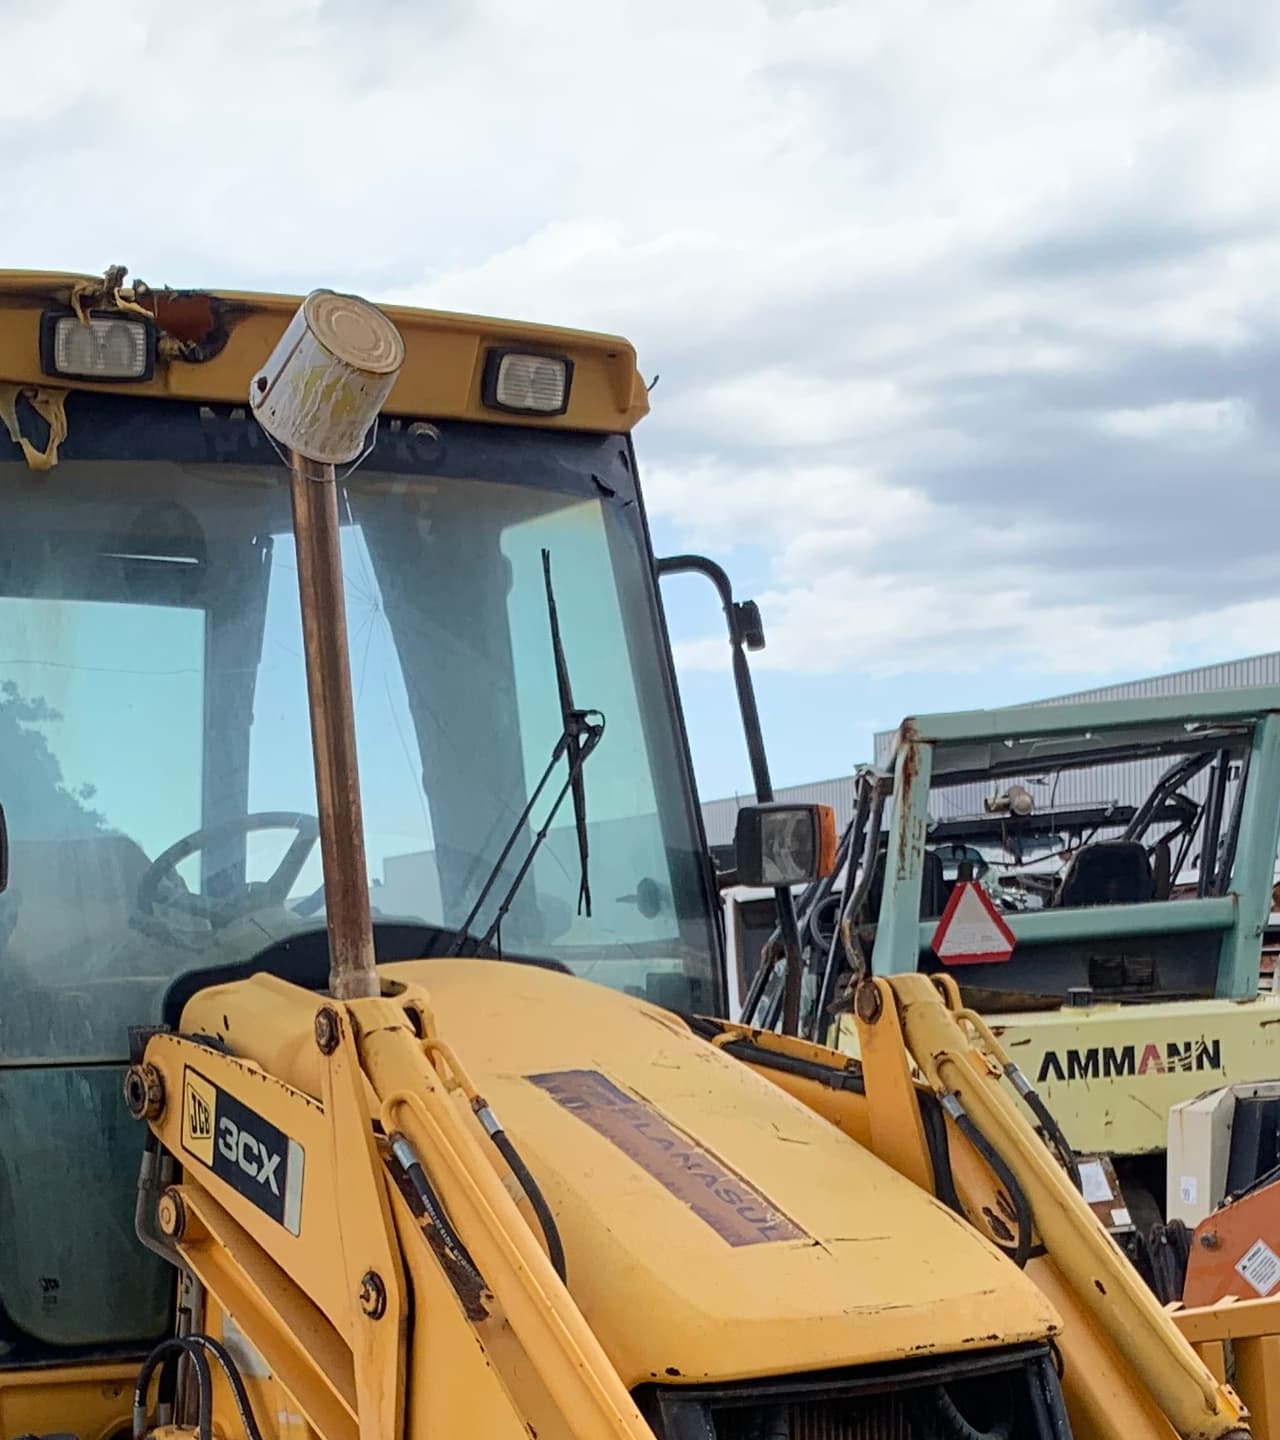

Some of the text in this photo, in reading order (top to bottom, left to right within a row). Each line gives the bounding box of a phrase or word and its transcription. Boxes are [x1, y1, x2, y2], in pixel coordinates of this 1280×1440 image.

[1037, 1039, 1221, 1083] AMMANN
[191, 1091, 282, 1198] JCB 3CX
